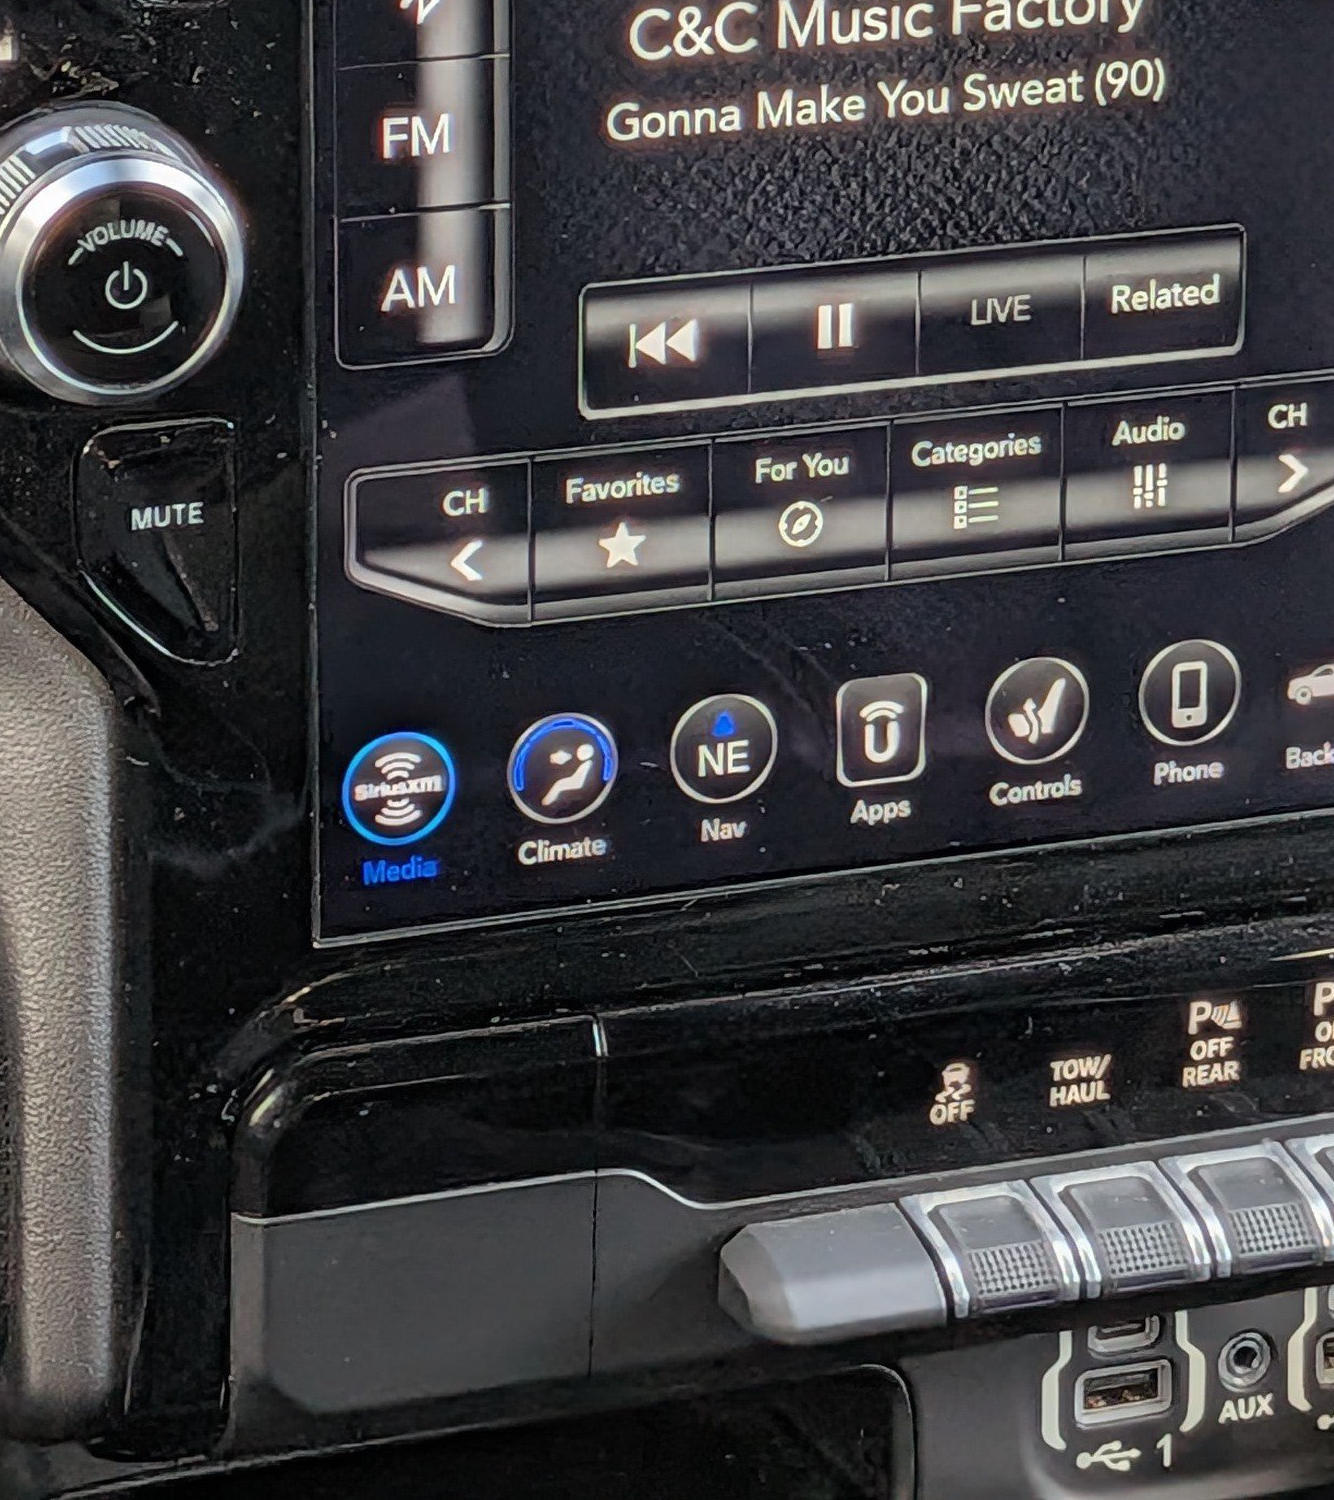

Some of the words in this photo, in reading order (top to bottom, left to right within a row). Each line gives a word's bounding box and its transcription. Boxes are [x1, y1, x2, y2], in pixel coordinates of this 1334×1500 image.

[629, 1, 759, 61] C&C
[606, 100, 741, 142] Gonna
[757, 83, 865, 130] Make
[877, 79, 949, 118] You
[963, 69, 1084, 113] Sweat
[1094, 57, 1166, 106] (90)
[383, 113, 452, 159] FM
[77, 219, 169, 254] VOLUME
[380, 265, 456, 312] AM
[1111, 273, 1221, 314] Related
[970, 295, 1032, 326] LIVE
[1111, 415, 1186, 447] Audio
[1268, 402, 1308, 430] CH
[912, 432, 1042, 468] Categories
[755, 456, 796, 484] For
[802, 452, 850, 478] You
[567, 470, 680, 504] Favorites
[131, 501, 204, 531] MUTE
[443, 488, 489, 518] CH
[697, 739, 750, 778] NE
[1153, 759, 1224, 786] Phone
[989, 774, 1082, 807] Controls
[850, 799, 912, 825] Apps
[701, 818, 748, 843] Nav
[518, 834, 607, 867] Climate
[362, 856, 439, 886] Media
[1190, 1037, 1234, 1061] OFF
[1050, 1053, 1112, 1081] TOW/
[1182, 1060, 1240, 1087] REAR
[1050, 1080, 1110, 1108] HAUL
[929, 1099, 975, 1127] OFF
[1218, 1393, 1275, 1424] AUX
[1156, 1433, 1173, 1468] 1
